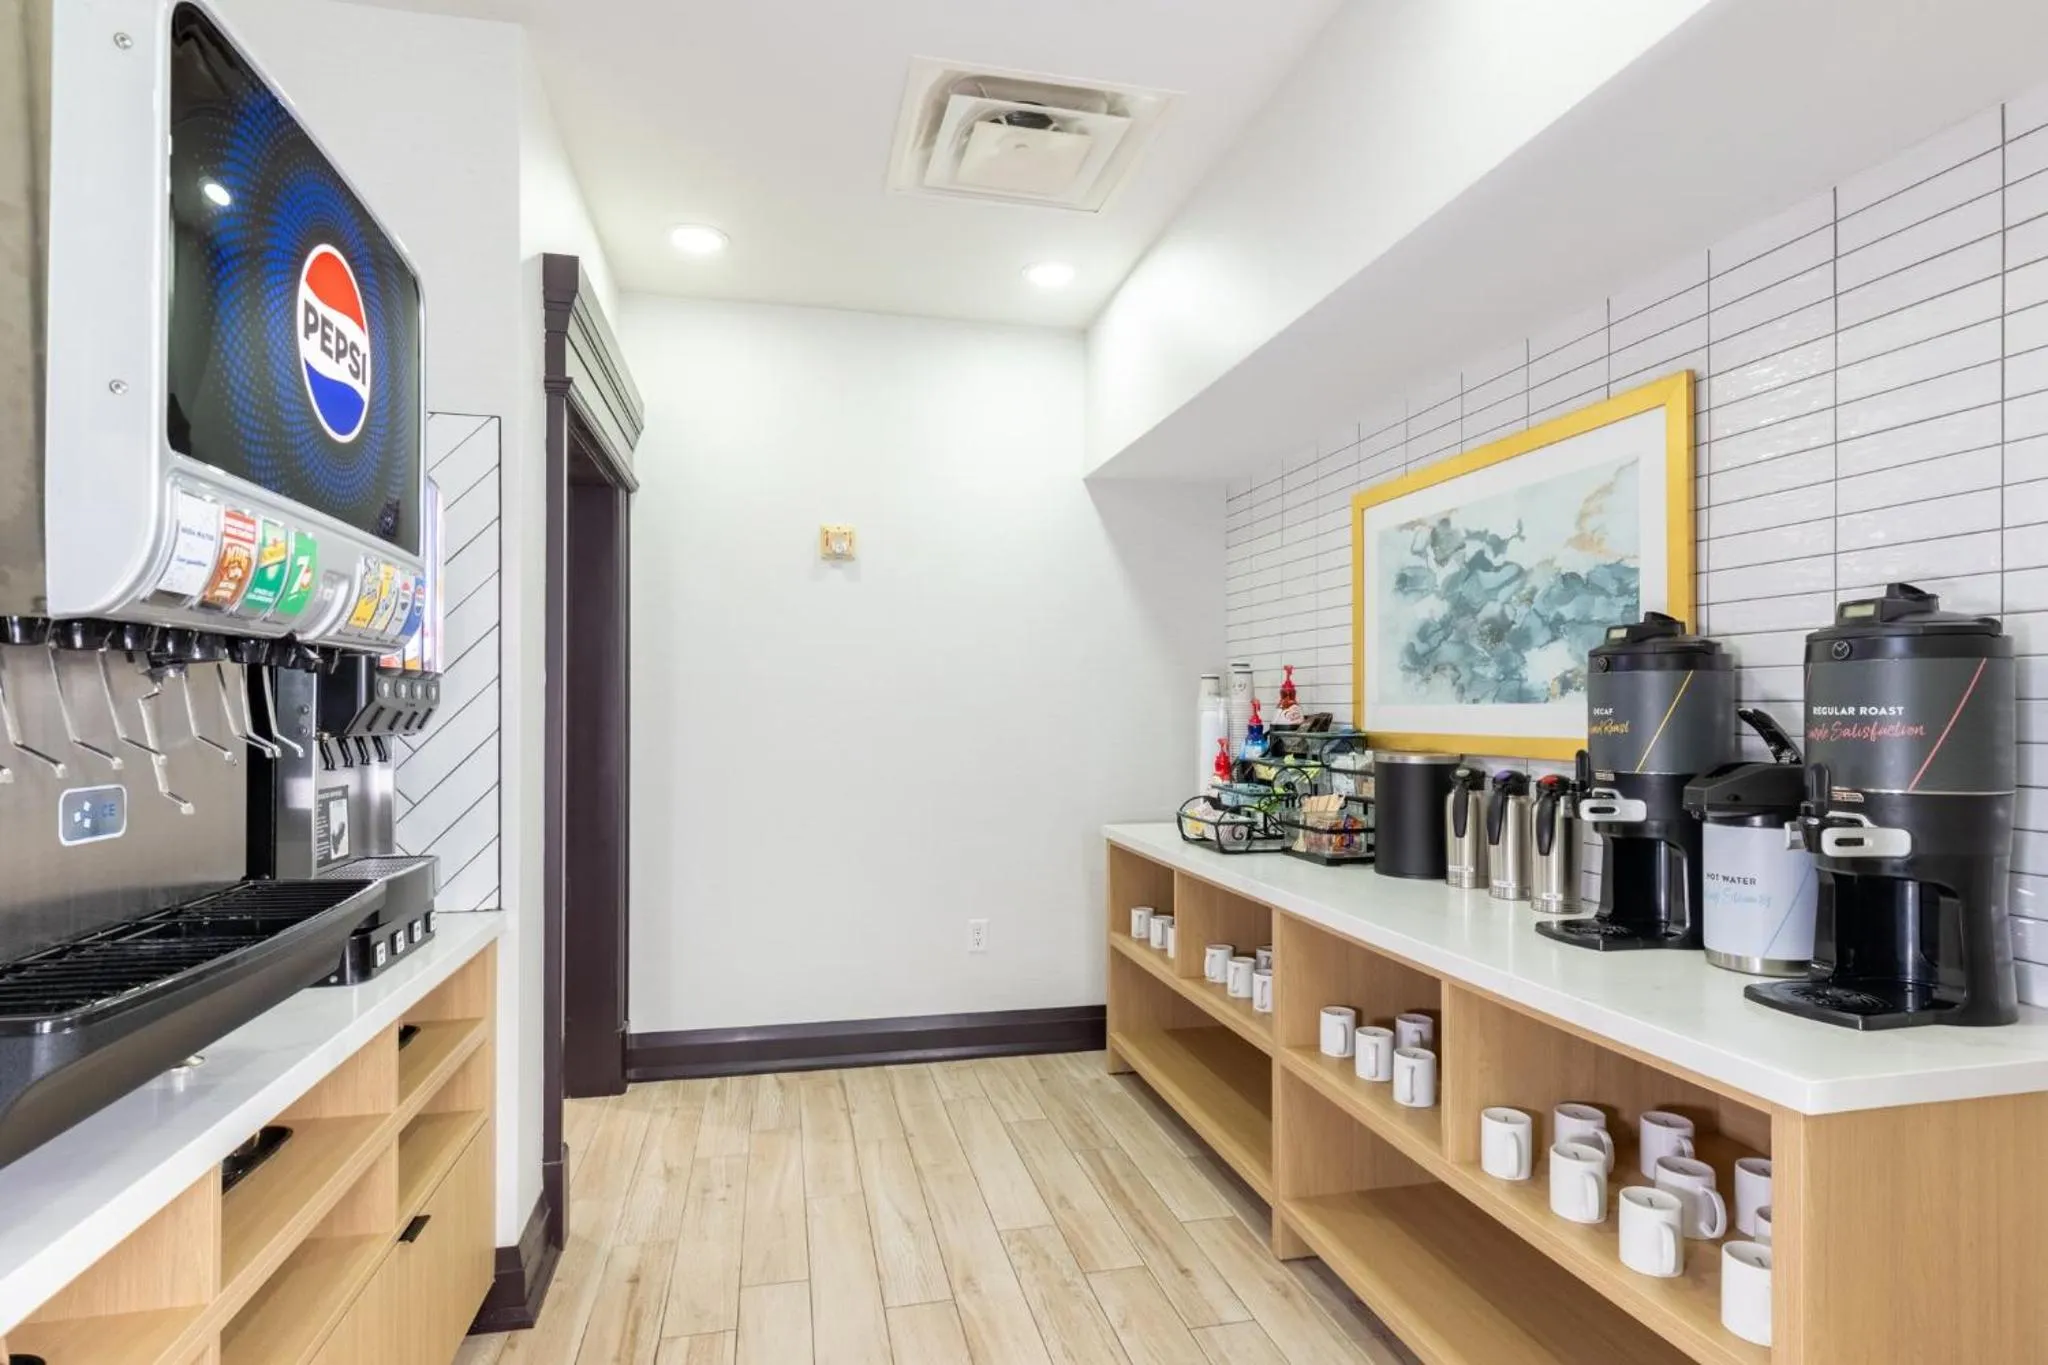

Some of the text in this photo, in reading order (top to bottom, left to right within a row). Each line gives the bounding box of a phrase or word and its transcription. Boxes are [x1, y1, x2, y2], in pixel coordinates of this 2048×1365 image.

[303, 297, 367, 387] PEPSI
[1812, 705, 1905, 716] REGULAR ROAST
[1721, 874, 1757, 885] WATER
